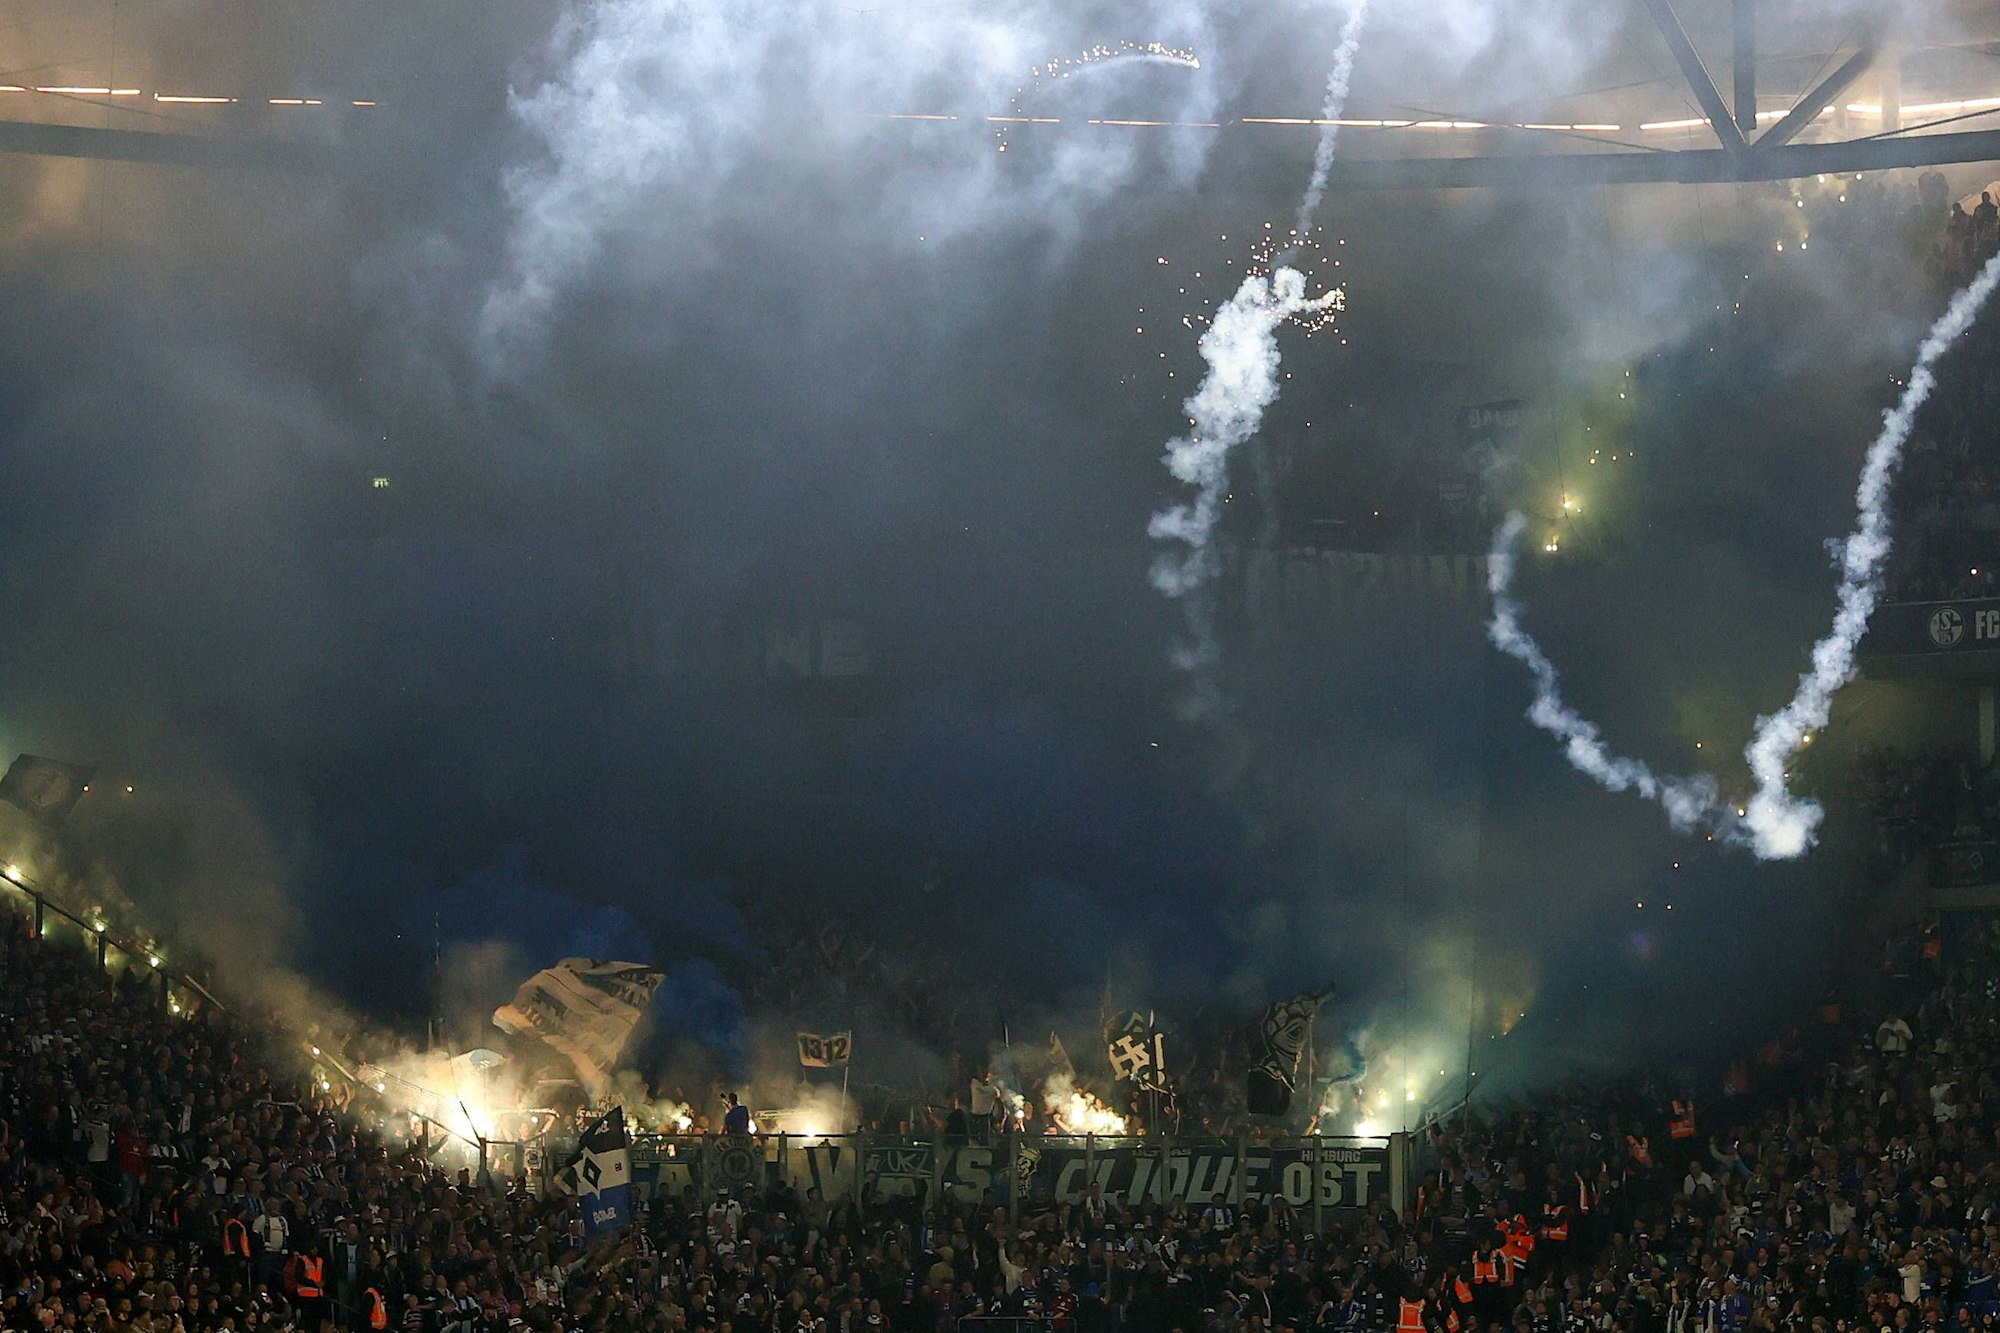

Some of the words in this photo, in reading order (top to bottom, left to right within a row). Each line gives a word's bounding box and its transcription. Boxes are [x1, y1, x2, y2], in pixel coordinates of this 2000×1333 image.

[1976, 610, 2000, 639] FC
[800, 1037, 848, 1059] 1312
[1283, 1161, 1381, 1207] OST
